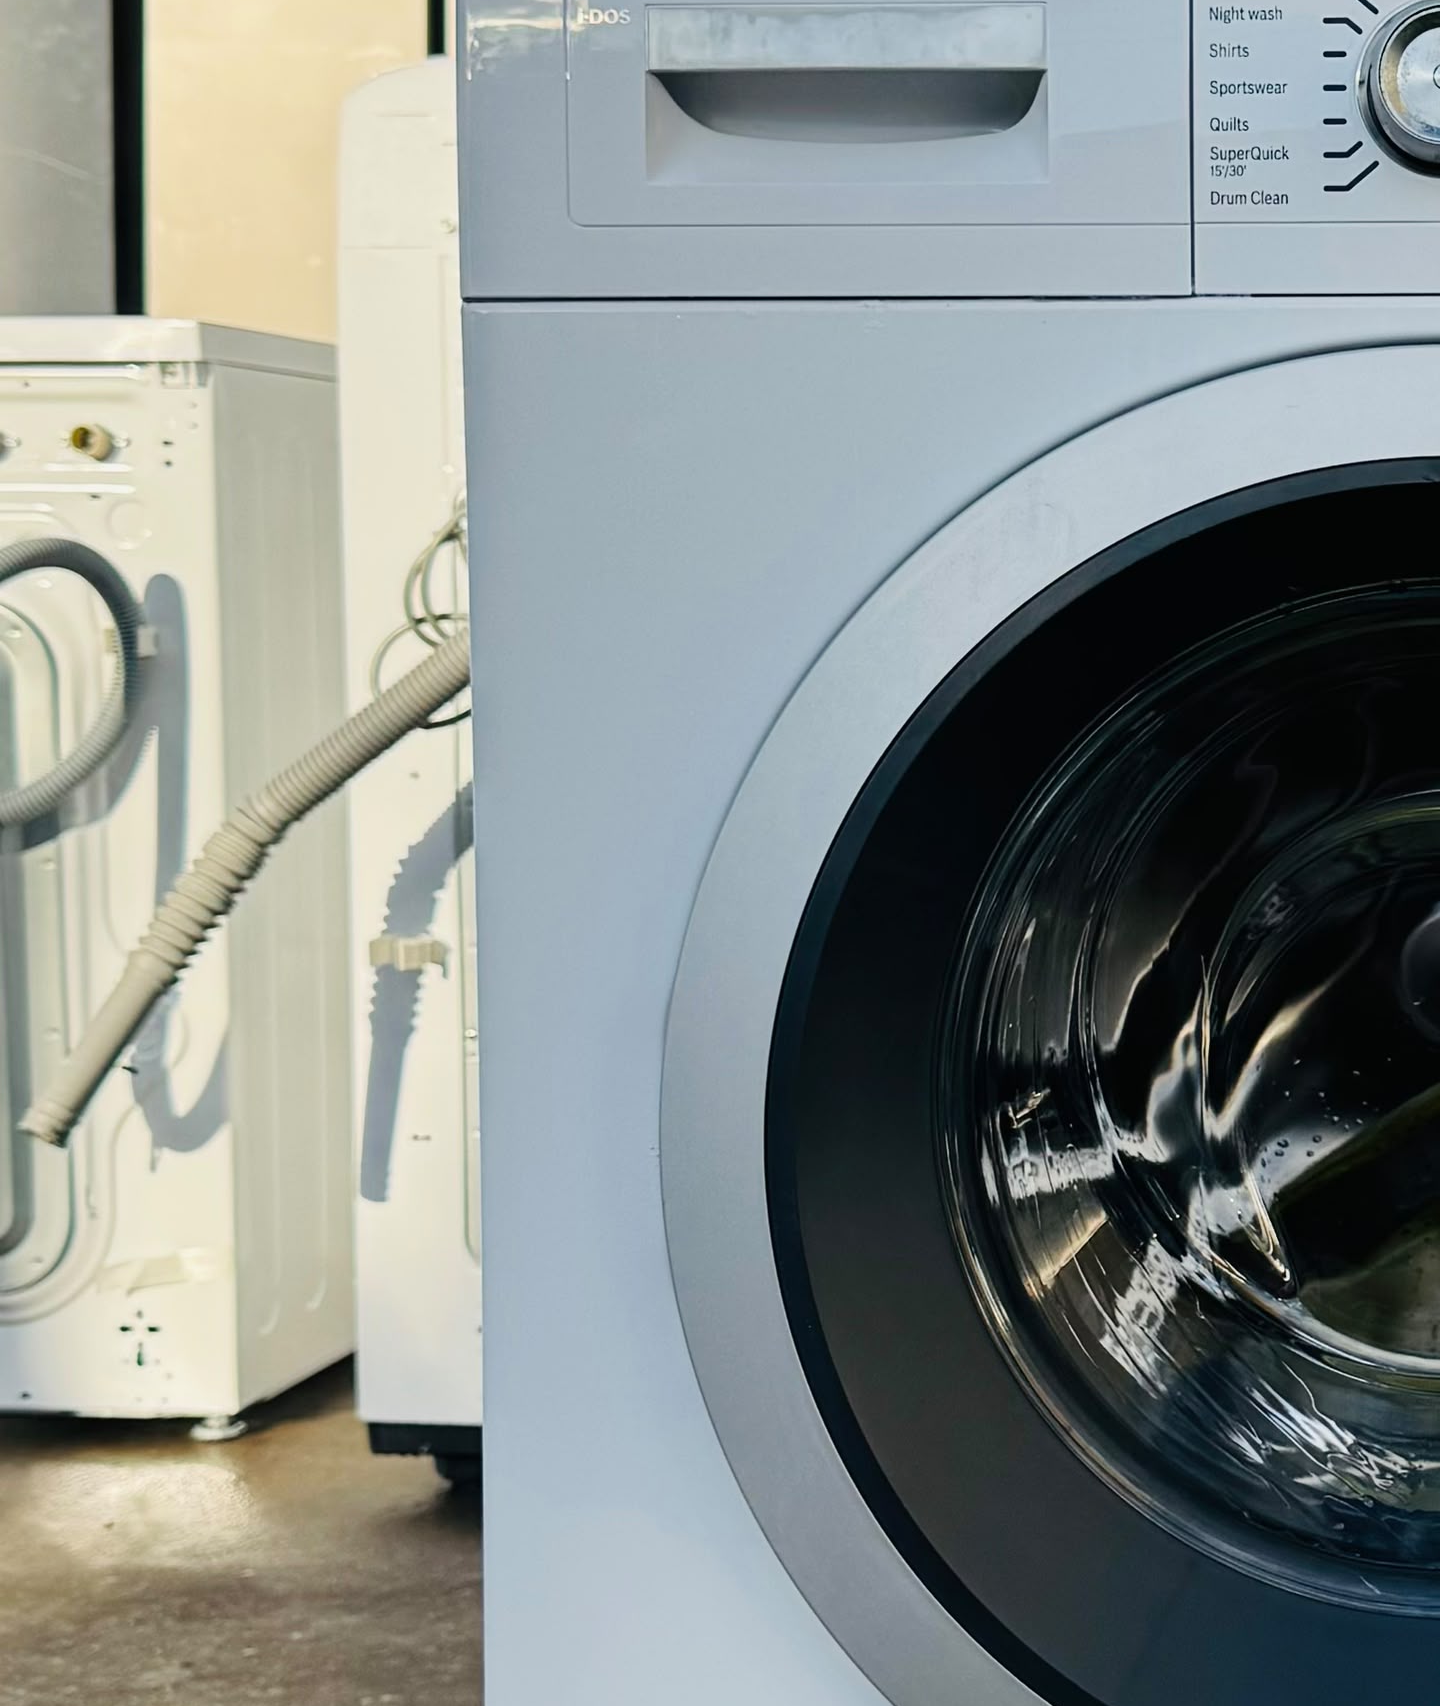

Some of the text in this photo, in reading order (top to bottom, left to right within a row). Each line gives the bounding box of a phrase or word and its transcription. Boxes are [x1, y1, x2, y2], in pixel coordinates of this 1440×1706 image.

[1208, 6, 1283, 23] Night wash
[1209, 43, 1250, 58] Shirts
[1209, 80, 1287, 97] Sportswear
[1209, 117, 1249, 133] Quilts
[1209, 146, 1290, 163] SuperQuick
[1210, 191, 1289, 205] Drum Clean
